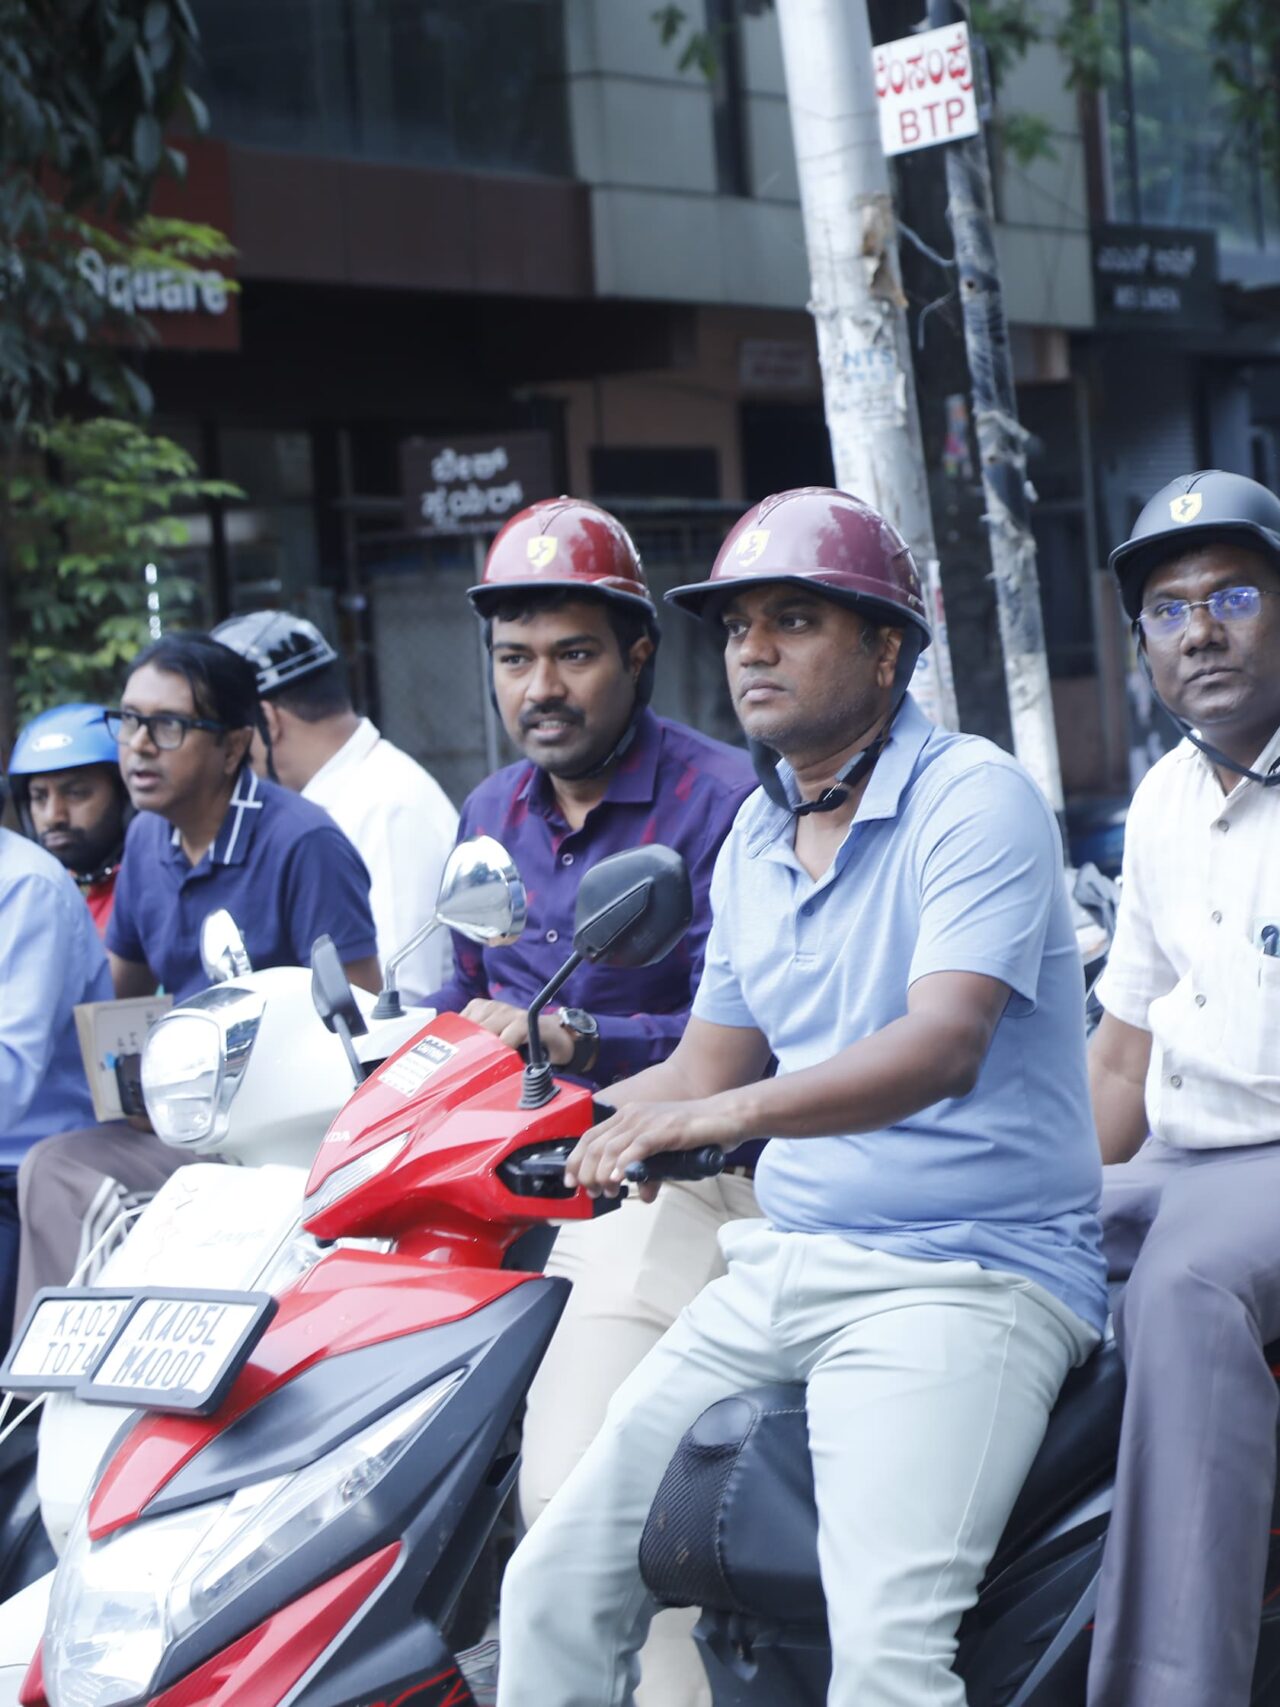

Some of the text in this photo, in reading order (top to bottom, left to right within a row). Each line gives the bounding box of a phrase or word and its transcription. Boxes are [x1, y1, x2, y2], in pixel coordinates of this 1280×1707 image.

[899, 98, 965, 143] BTP
[138, 1303, 227, 1346] KA05L
[111, 1345, 206, 1387] M4000
